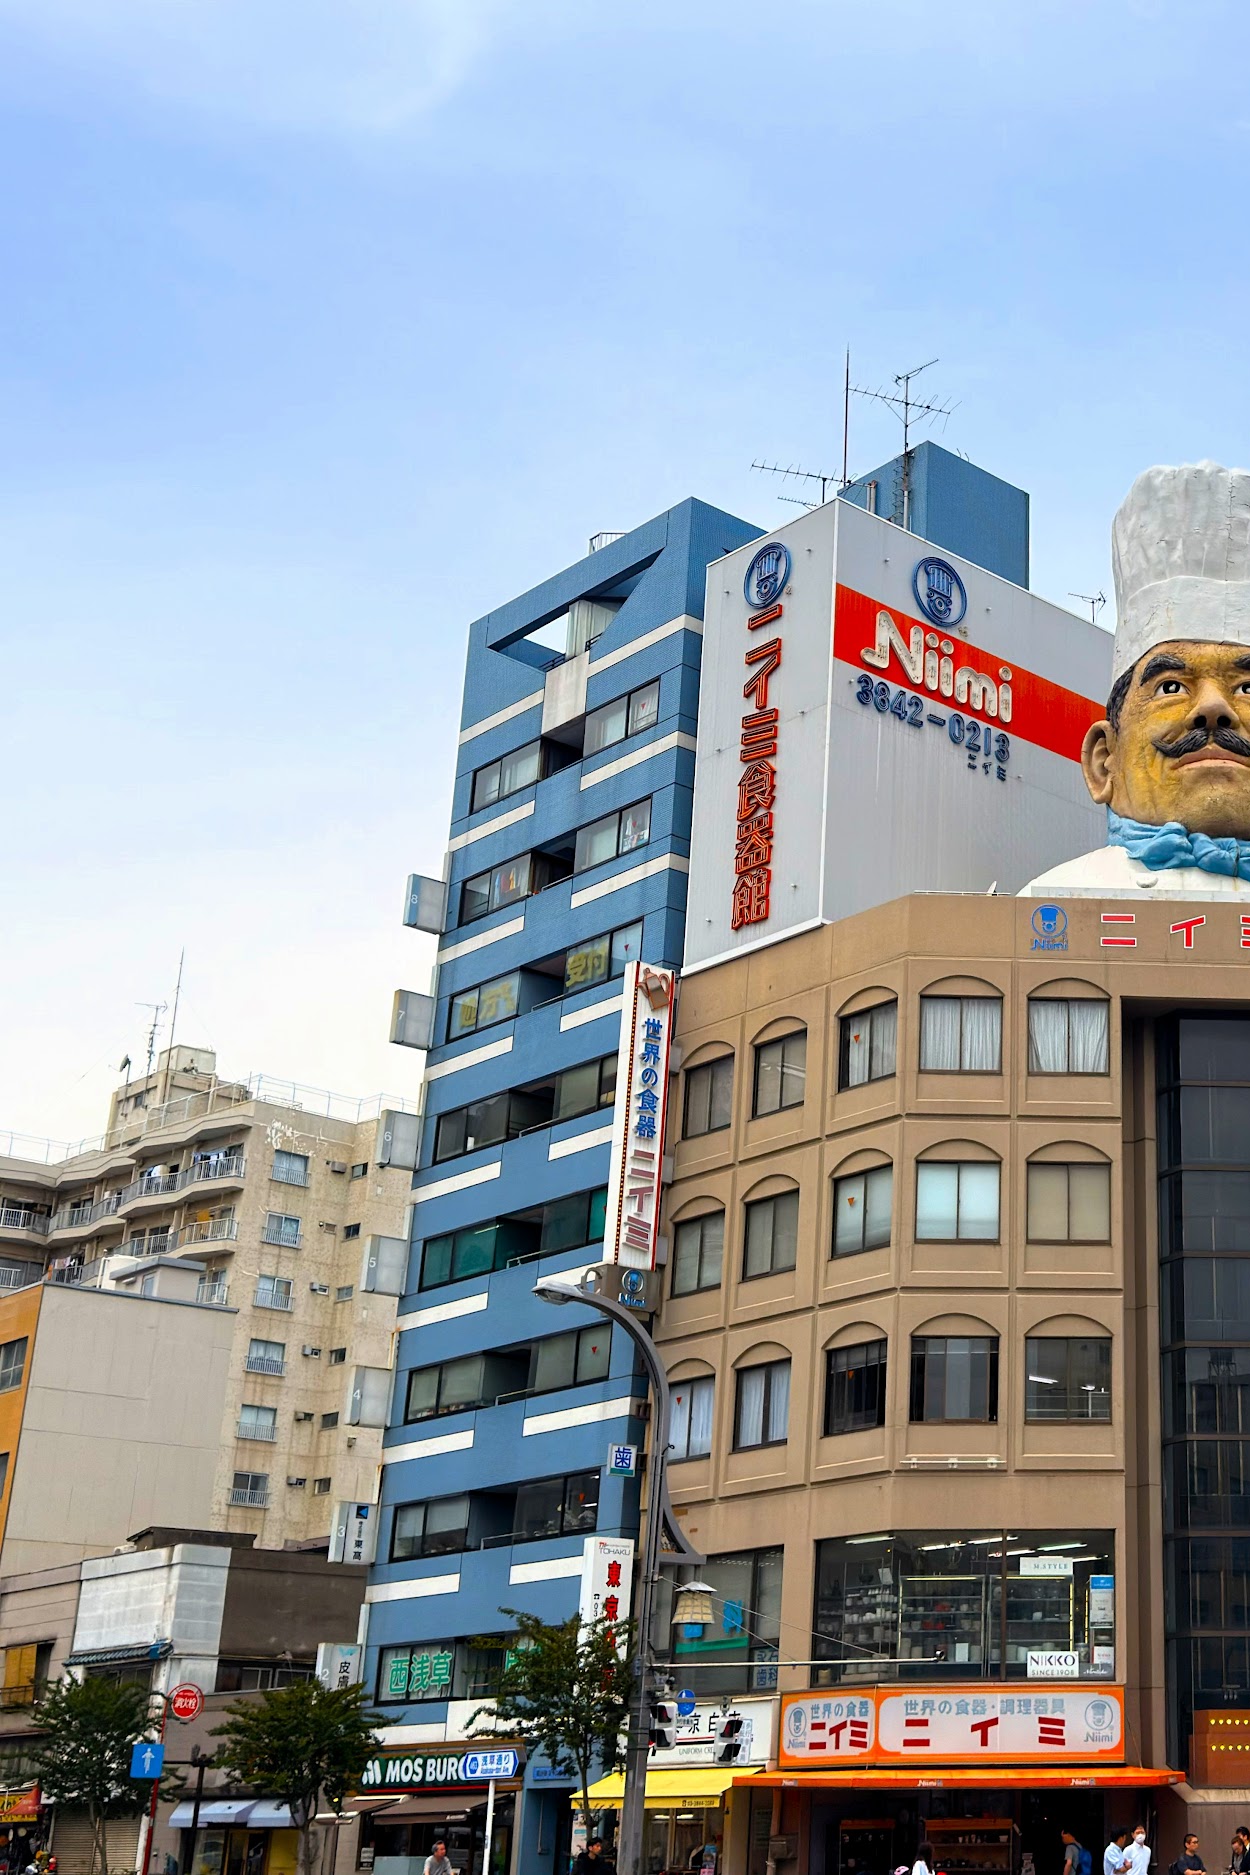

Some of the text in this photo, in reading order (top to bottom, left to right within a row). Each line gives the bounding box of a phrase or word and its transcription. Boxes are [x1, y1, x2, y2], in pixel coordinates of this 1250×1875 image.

[860, 610, 1014, 724] Niimi
[856, 673, 1011, 763] 3842-0213
[731, 604, 782, 931] ニイミ食器館
[411, 894, 418, 904] 8
[1031, 934, 1069, 951] Niimi
[398, 1010, 405, 1021] 7
[384, 1131, 391, 1141] 6
[624, 1017, 663, 1251] 世界の食器 ニイミ
[369, 1257, 376, 1268] 5
[353, 1388, 361, 1400] 4
[615, 1447, 632, 1468] 歯
[337, 1526, 345, 1537] 3
[599, 1548, 631, 1556] TOHAKU
[1030, 1654, 1076, 1667] NIKKO
[322, 1668, 330, 1681] 2
[389, 1650, 452, 1694] 西浅草
[810, 1700, 870, 1720] 世界の食器
[904, 1698, 1066, 1718] 世界の食器・調理器具
[808, 1719, 868, 1750] ニイミ
[903, 1716, 1066, 1747] ニイミ
[1083, 1731, 1114, 1743] Niimi
[385, 1757, 424, 1783] MOS
